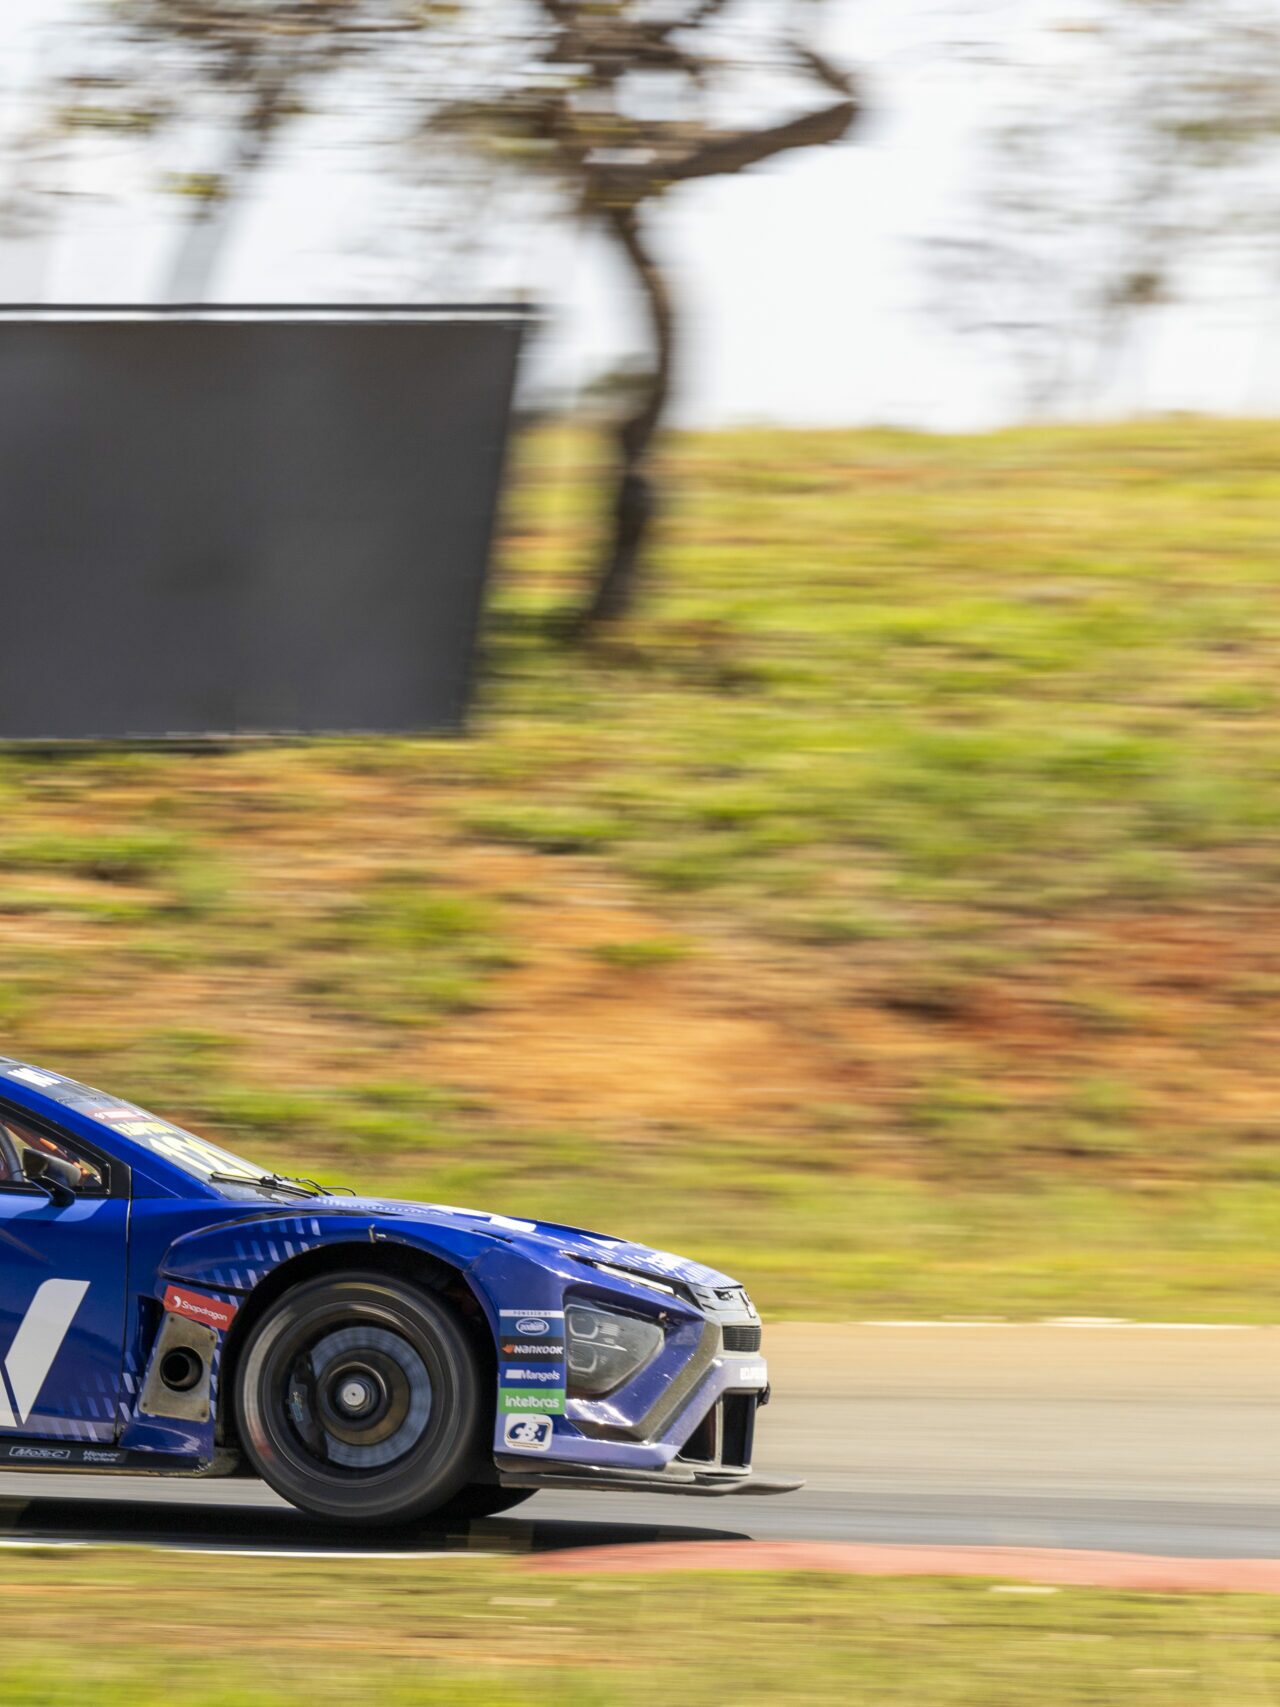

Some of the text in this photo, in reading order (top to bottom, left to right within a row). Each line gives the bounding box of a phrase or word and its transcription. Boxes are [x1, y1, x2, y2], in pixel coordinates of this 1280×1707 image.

[181, 1300, 228, 1323] Snapdragon
[520, 1370, 561, 1382] Mangels
[505, 1395, 560, 1408] intelbras
